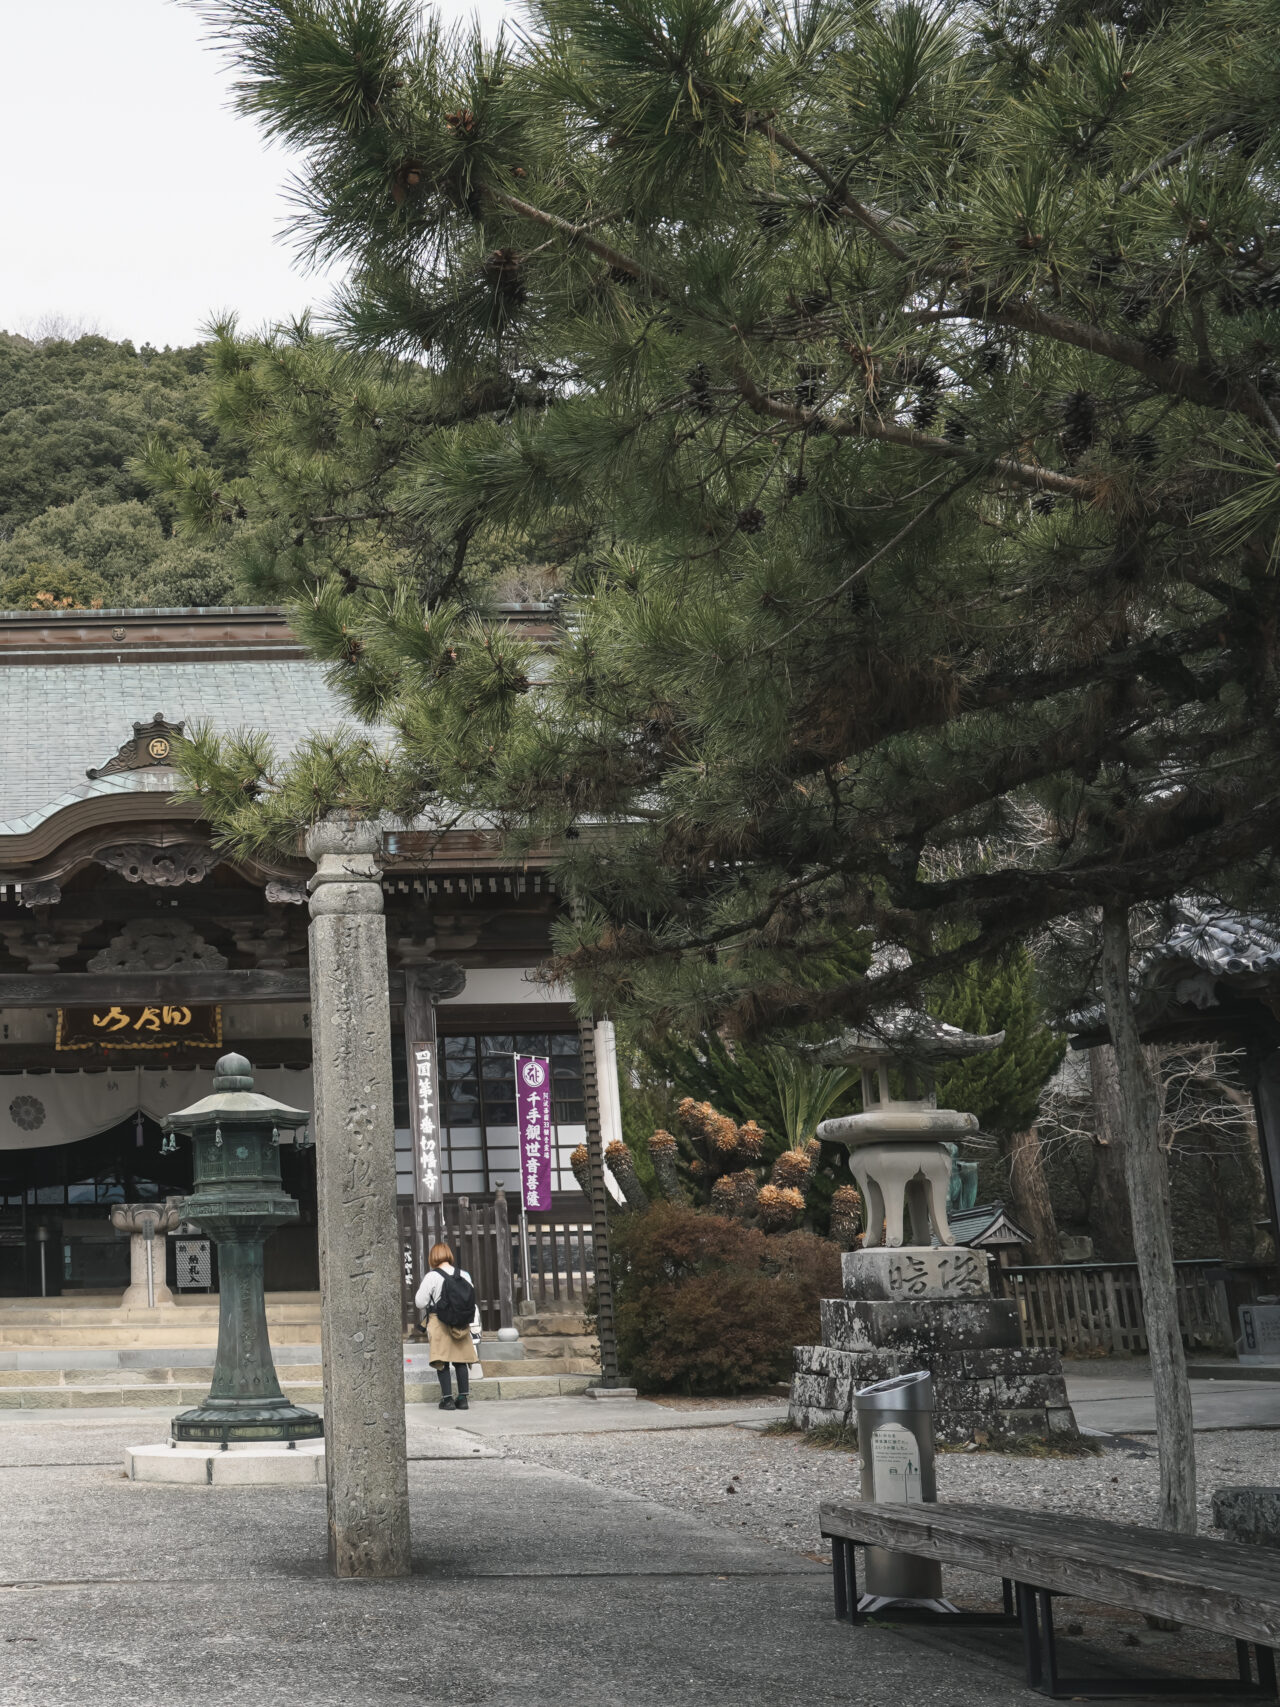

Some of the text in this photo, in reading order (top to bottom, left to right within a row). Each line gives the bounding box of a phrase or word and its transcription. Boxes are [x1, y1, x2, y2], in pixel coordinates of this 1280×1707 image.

[525, 1091, 542, 1207] 千手観世音菩薩
[188, 1255, 200, 1283] 納札入
